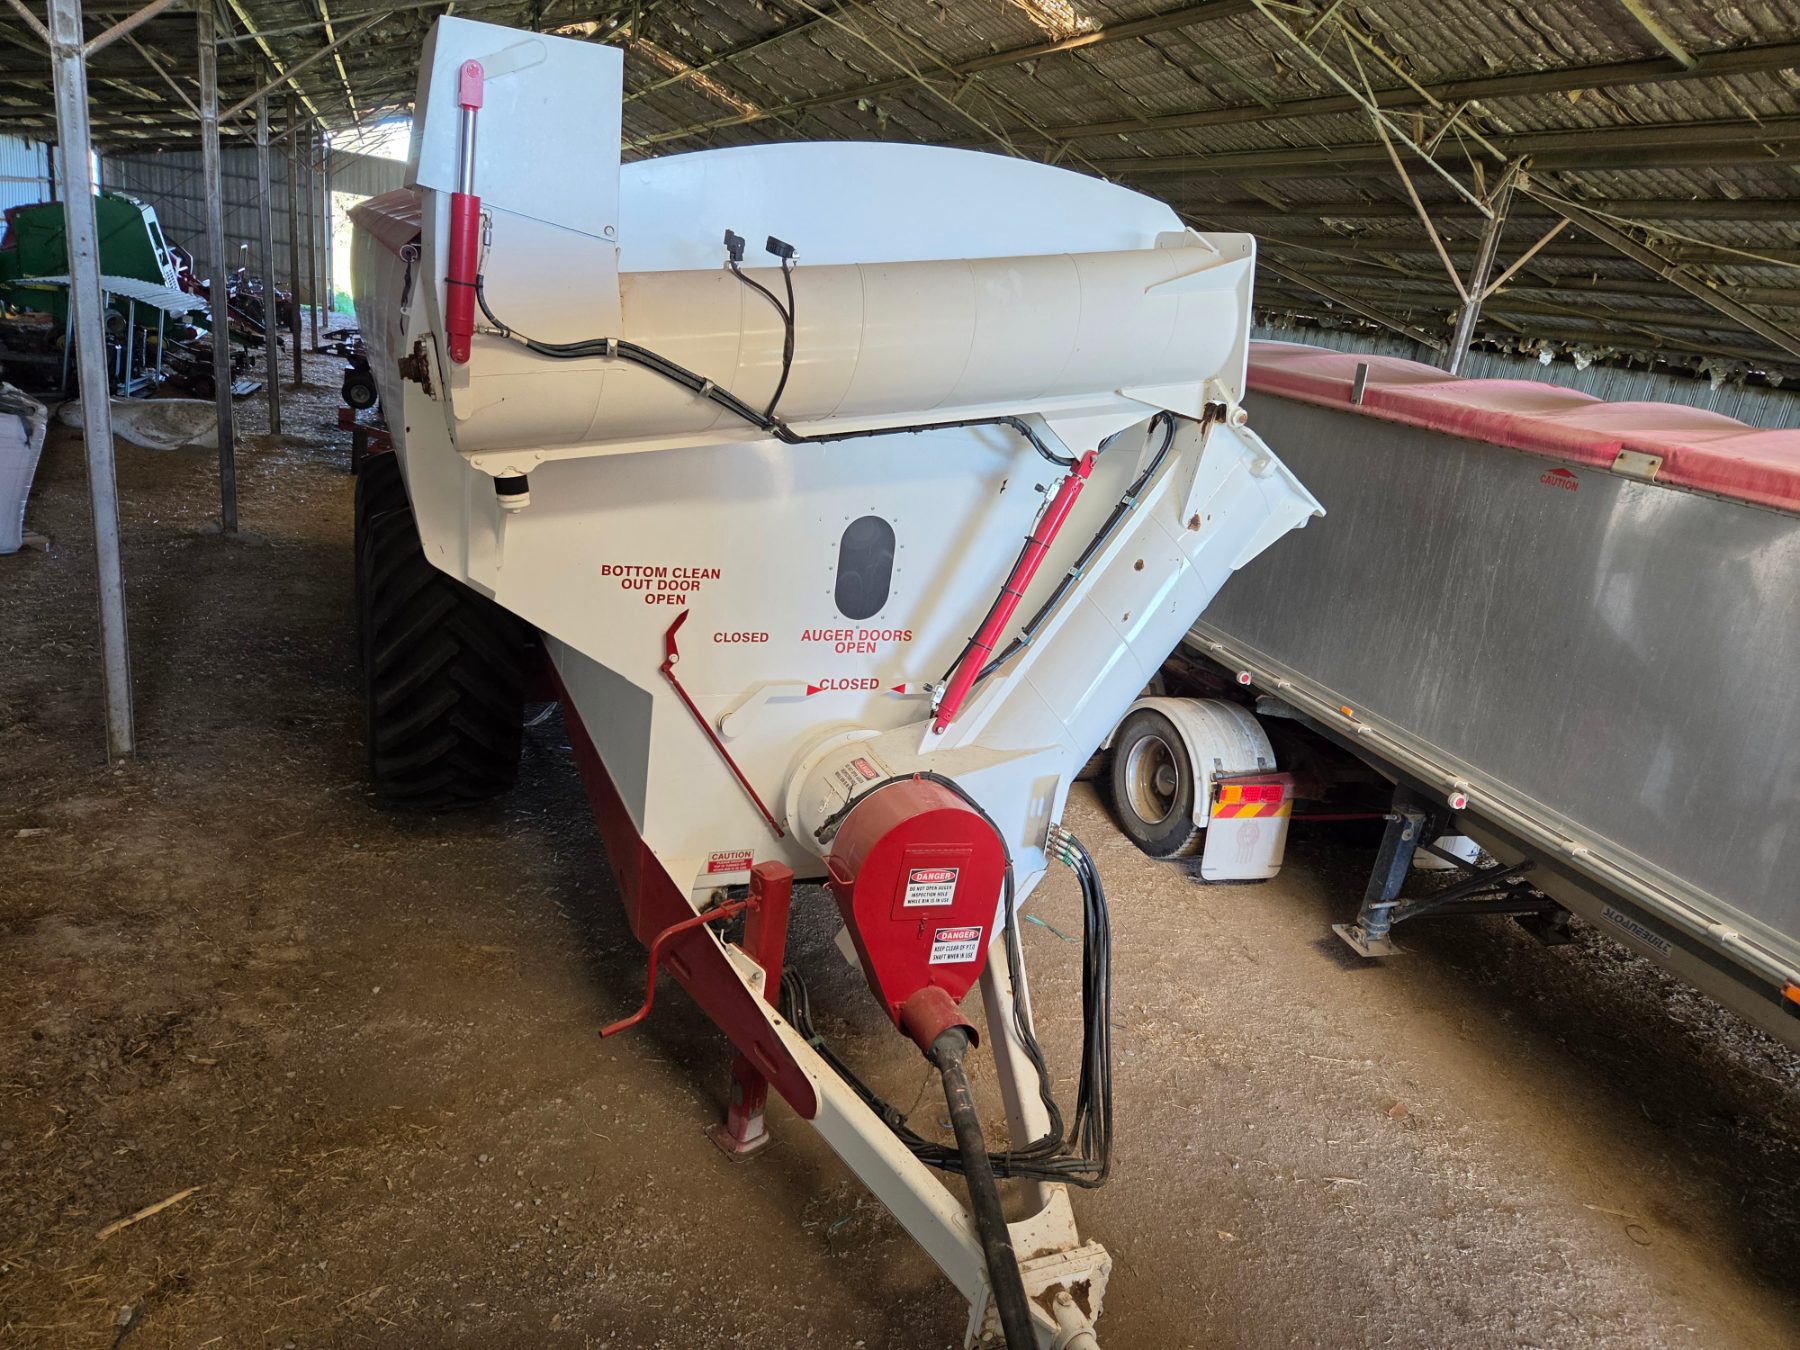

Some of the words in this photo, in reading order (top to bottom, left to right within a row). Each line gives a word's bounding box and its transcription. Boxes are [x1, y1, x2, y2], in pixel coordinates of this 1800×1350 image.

[1540, 474, 1579, 491] CAUTION
[601, 564, 667, 578] BOTTOM
[672, 567, 721, 580] CLEAN
[621, 578, 653, 590] OUT
[657, 580, 700, 591] DOOR
[645, 593, 686, 605] OPEN
[713, 632, 769, 643] CLOSED
[801, 629, 854, 642] AUGER
[858, 629, 912, 642] DOORS
[834, 642, 877, 654] OPEN
[819, 678, 880, 690] CLOSED
[711, 851, 751, 861] CAUTION
[916, 872, 951, 880] DANGER
[941, 931, 975, 940] DANGER
